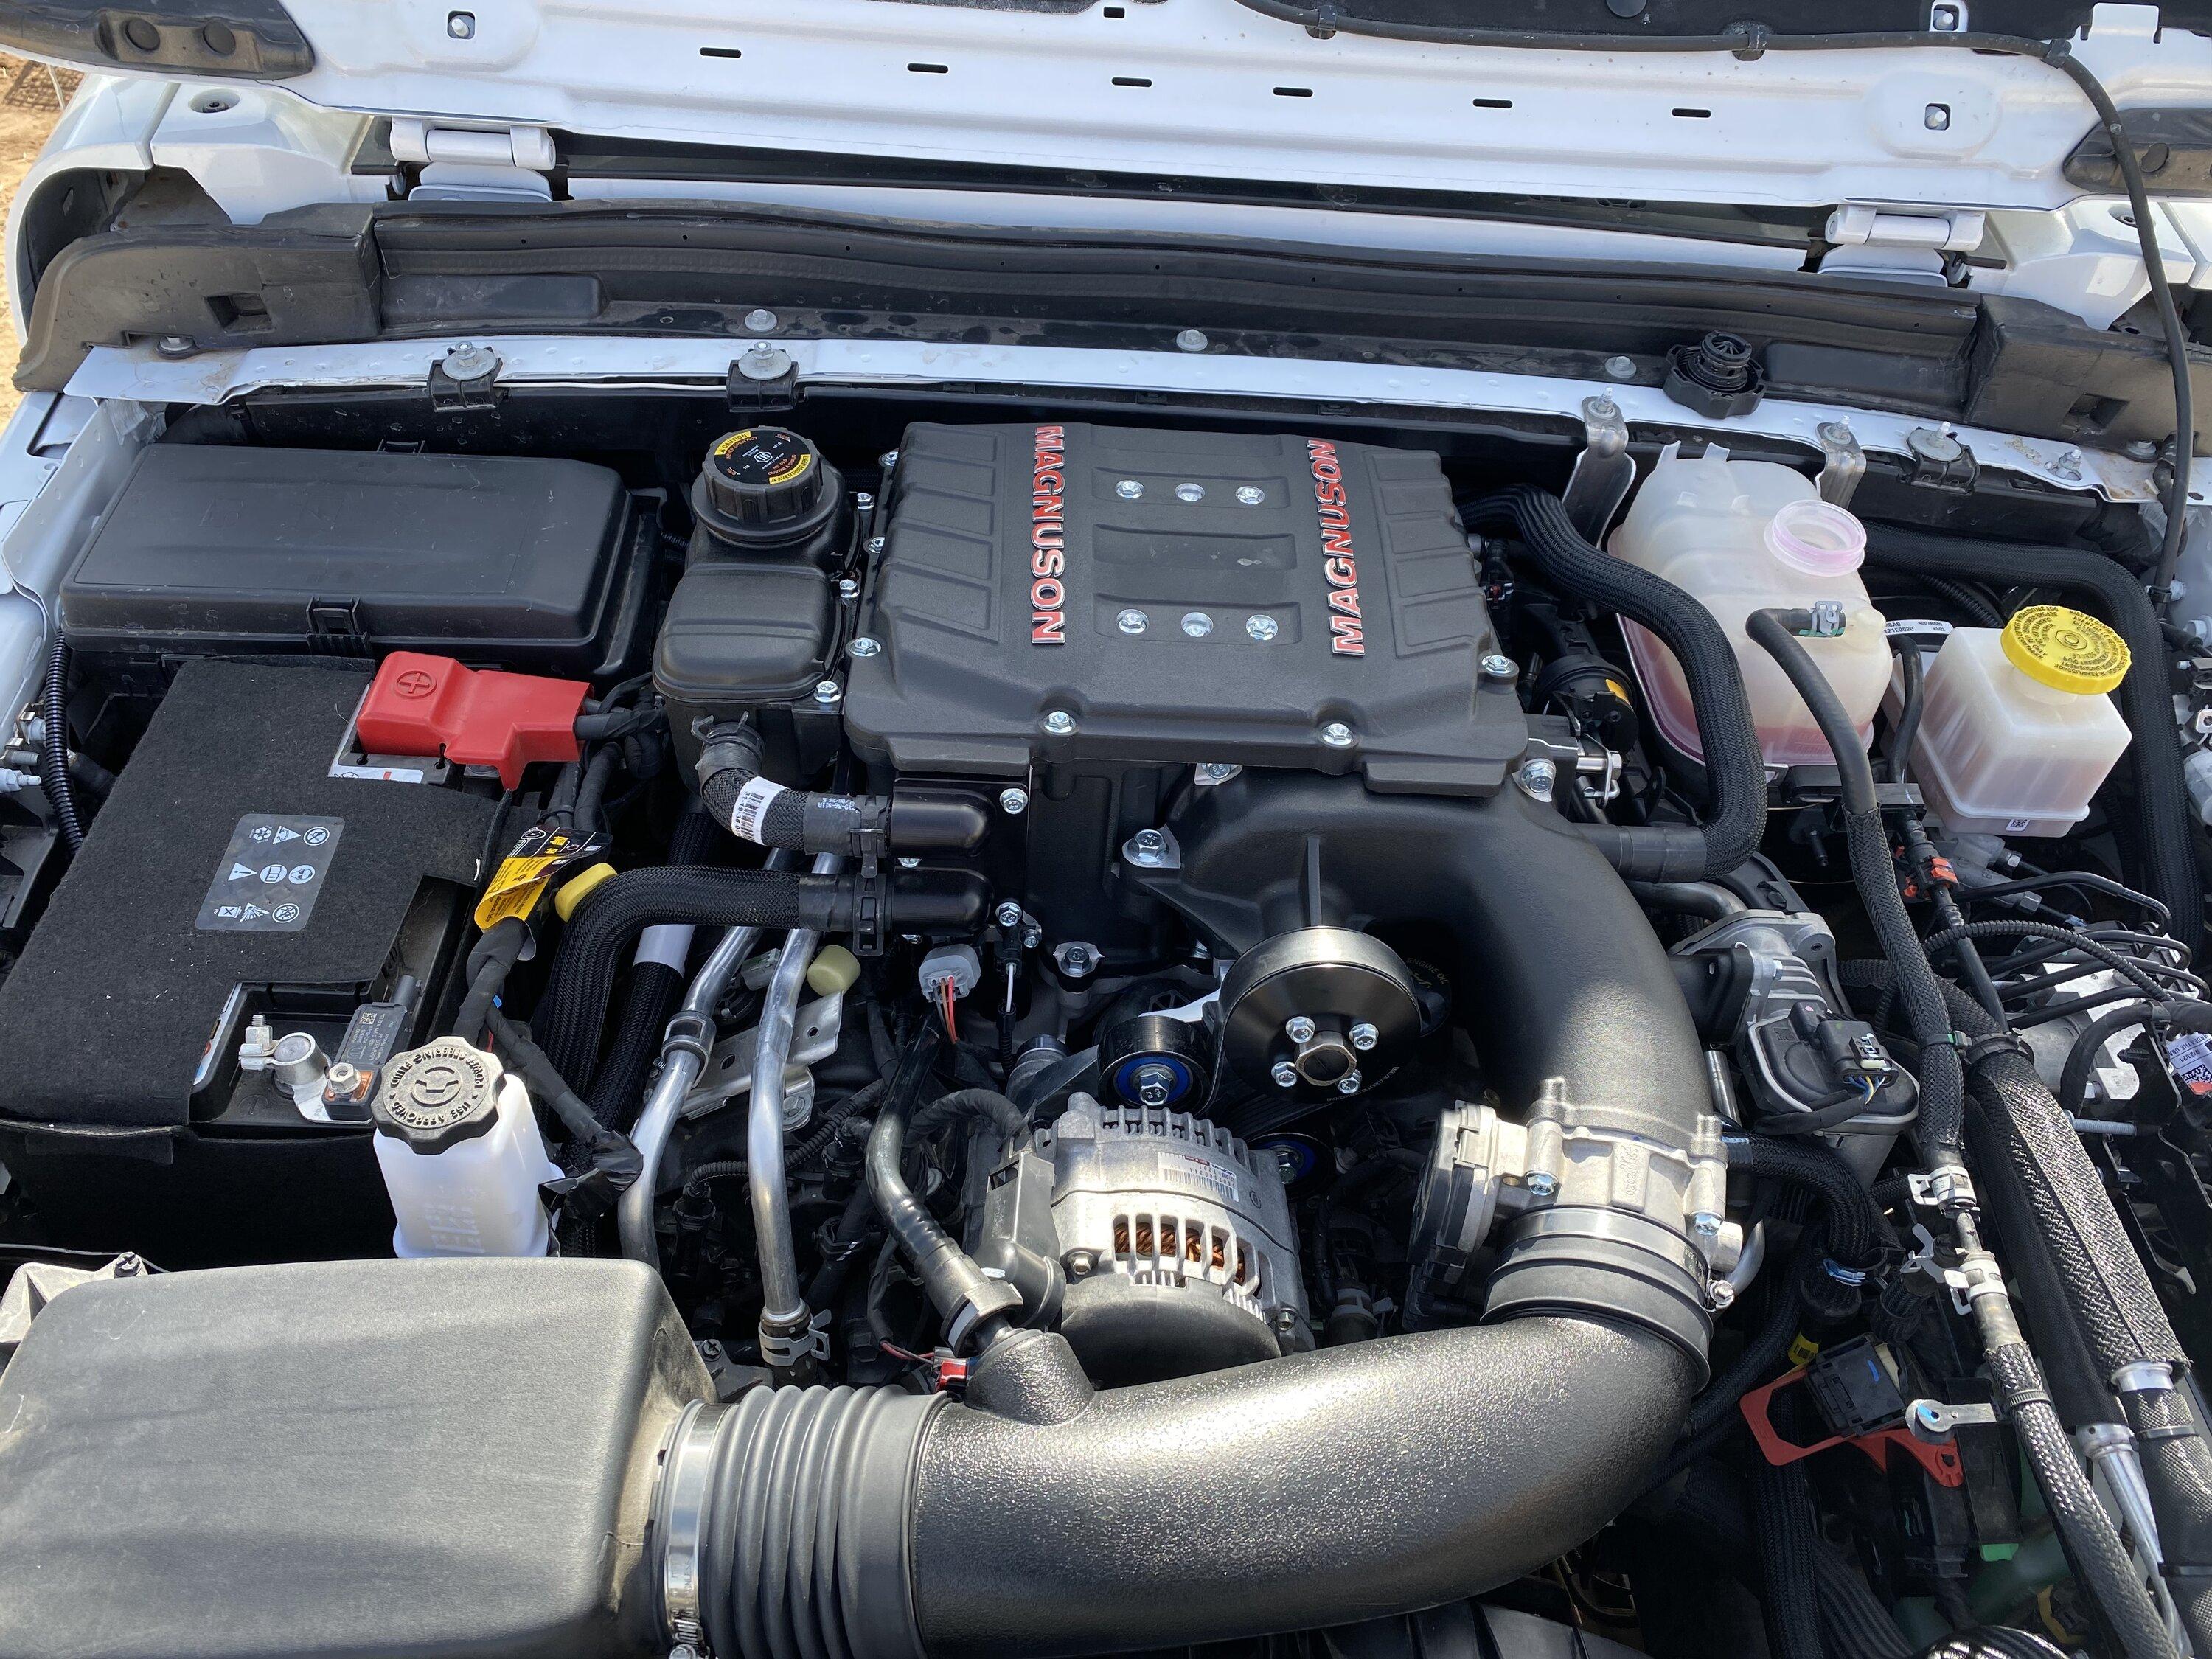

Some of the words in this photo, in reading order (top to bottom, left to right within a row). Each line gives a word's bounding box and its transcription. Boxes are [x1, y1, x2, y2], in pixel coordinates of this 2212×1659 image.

[722, 433, 748, 449] CAUTION
[777, 456, 810, 481] AVERTISSEMENT
[1031, 425, 1065, 644] MAGNUSON
[1307, 439, 1365, 655] MAGNUSON
[2180, 1043, 2192, 1051] THE
[2195, 1034, 2209, 1044] MADE
[413, 1047, 467, 1065] STEERING
[2168, 1048, 2180, 1057] USA
[390, 1061, 414, 1088] FLUID
[465, 1054, 484, 1089] POWER
[392, 1102, 445, 1126] APPROVED
[450, 1102, 471, 1120] USE
